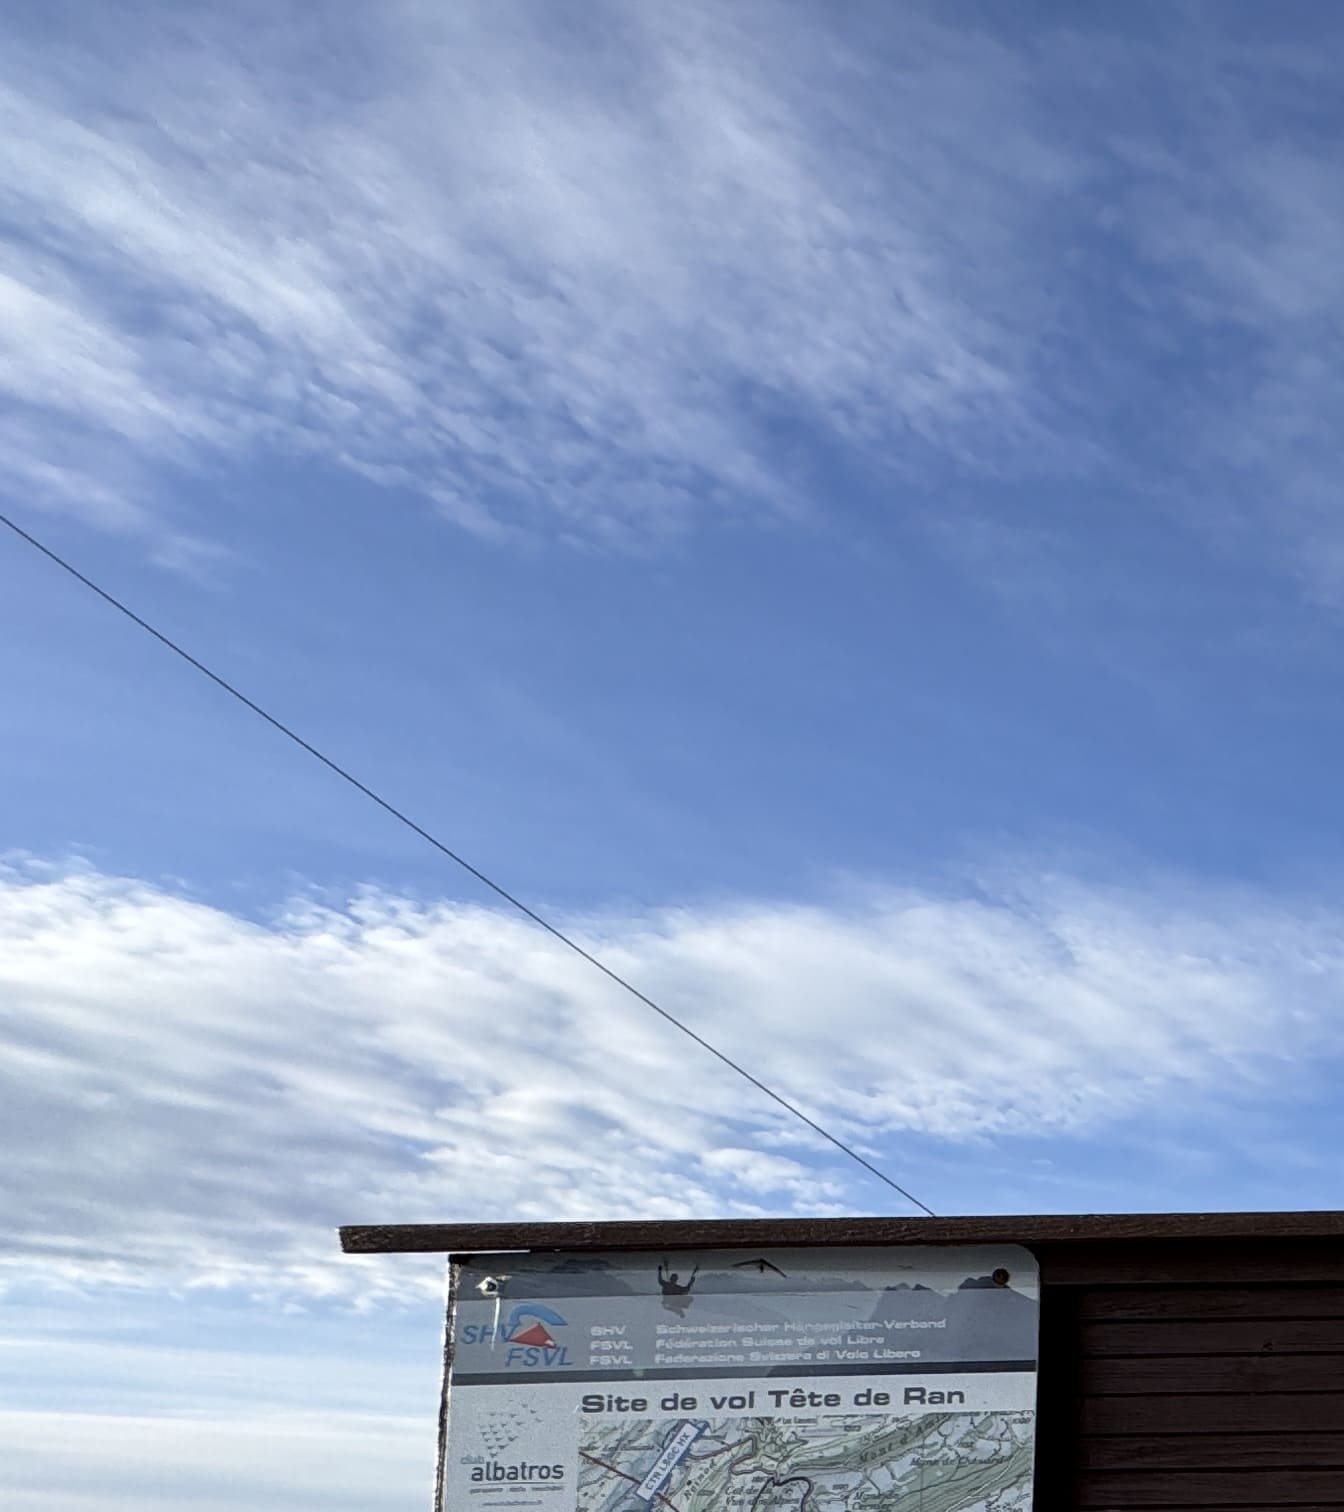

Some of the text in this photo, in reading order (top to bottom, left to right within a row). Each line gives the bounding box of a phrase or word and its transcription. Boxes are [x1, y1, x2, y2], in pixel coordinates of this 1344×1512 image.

[460, 1324, 517, 1345] SHV
[590, 1325, 627, 1336] SHV
[590, 1335, 884, 1350] FSVL Fédération Suisse de vol Libre
[505, 1347, 574, 1367] FSVL
[589, 1348, 921, 1365] FSVL Federazione Svizzera di Volo Libero
[581, 1387, 965, 1413] Site de vol Tête de Ran
[471, 1461, 565, 1482] albatros
